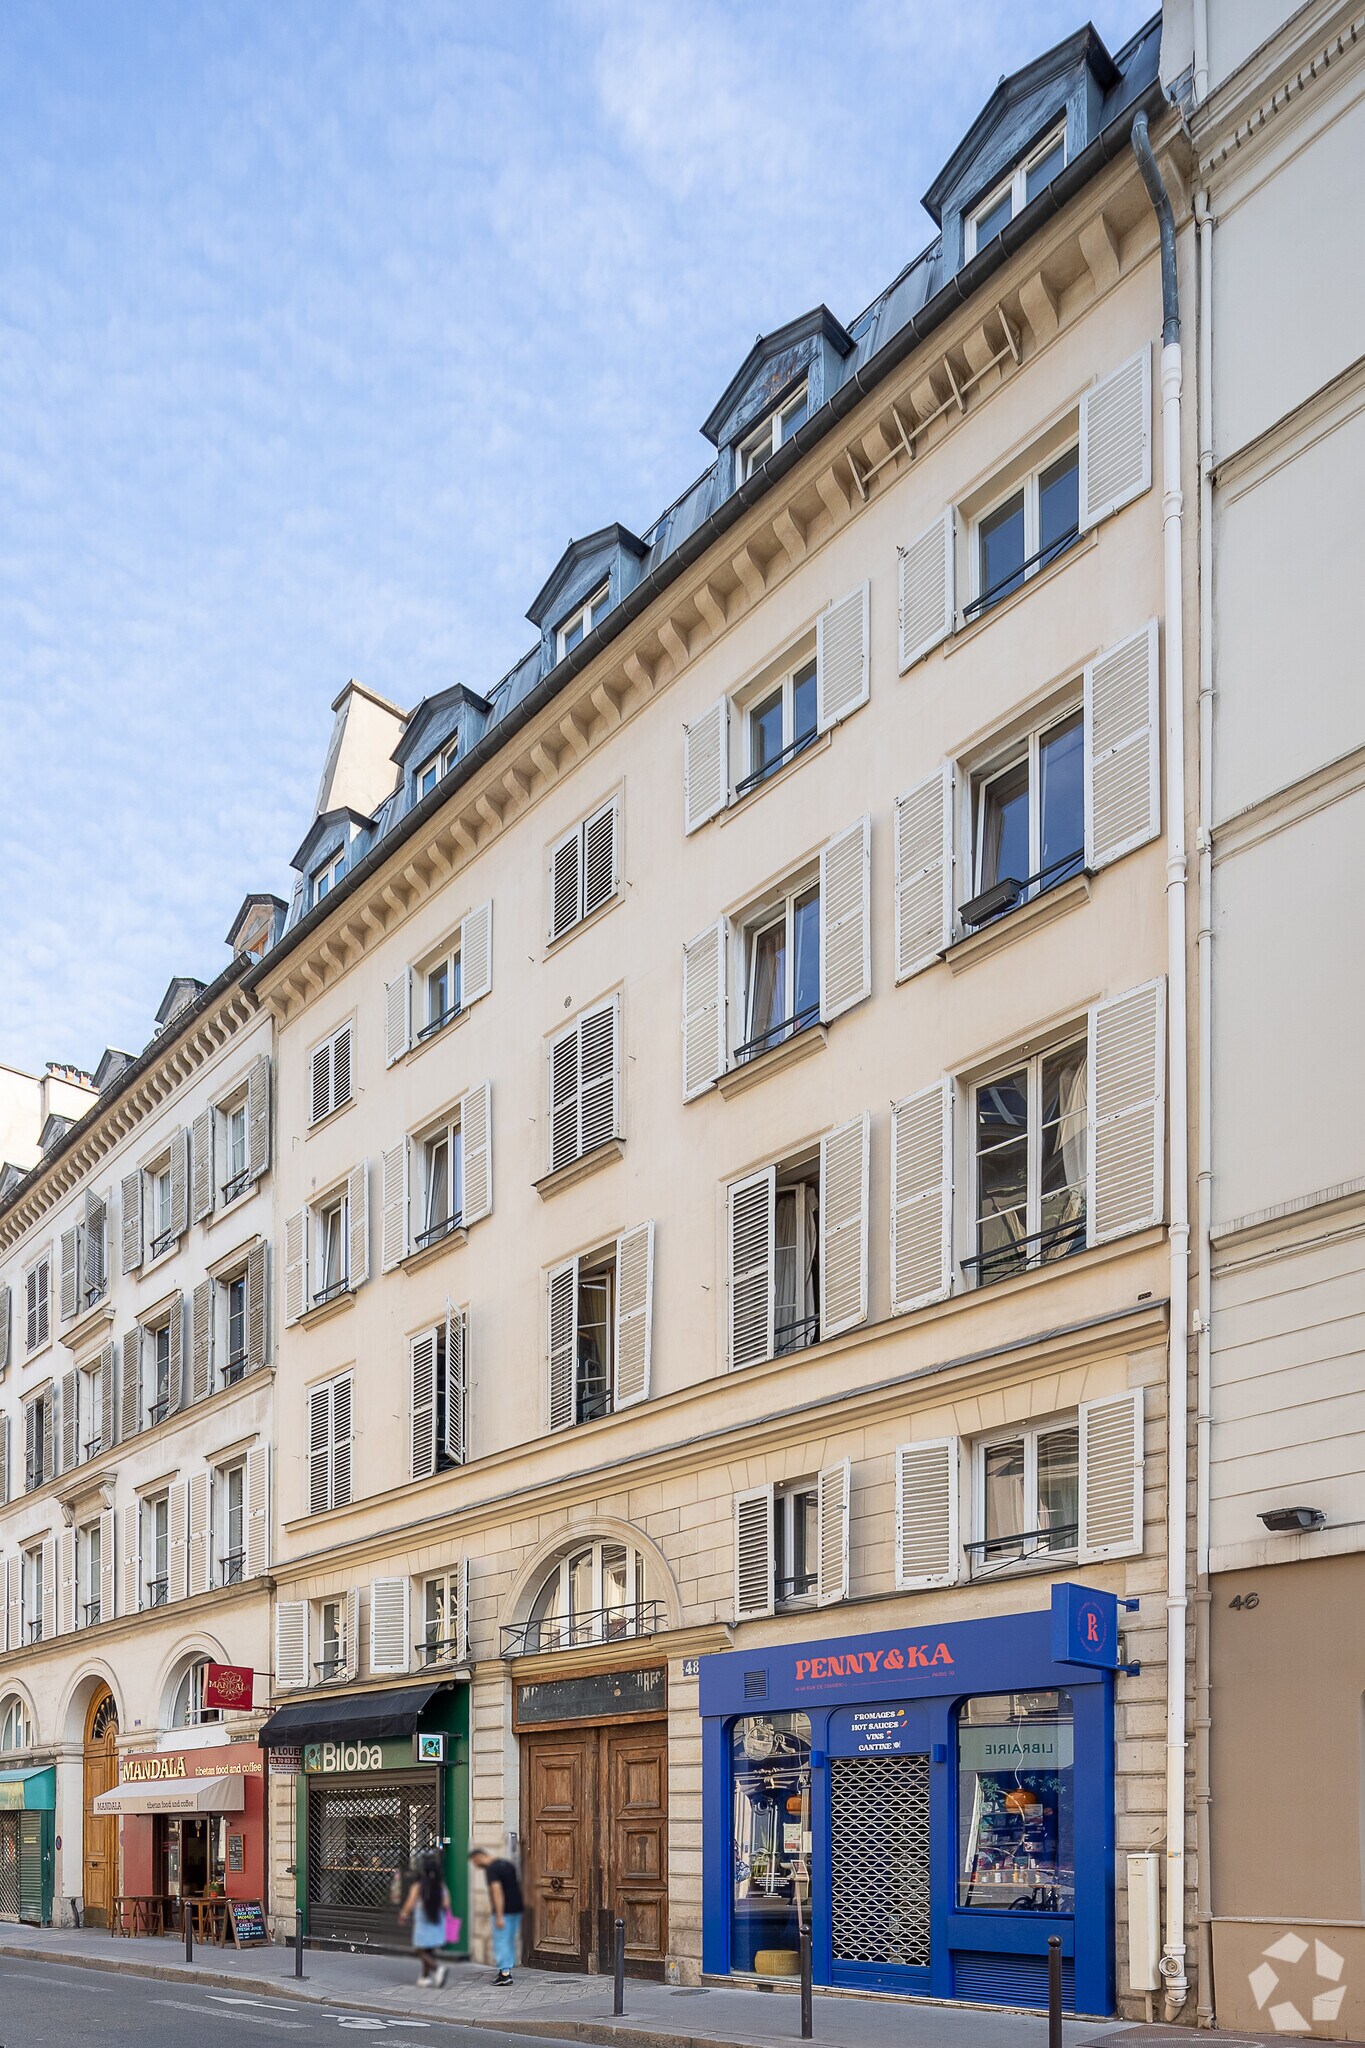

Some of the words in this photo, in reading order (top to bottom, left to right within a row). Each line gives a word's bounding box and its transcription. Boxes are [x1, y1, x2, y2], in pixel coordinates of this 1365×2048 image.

[1229, 1592, 1260, 1611] 46
[795, 1642, 955, 1681] PENNY&KA
[685, 1660, 699, 1675] 48
[854, 1711, 896, 1721] FROMAGES
[851, 1723, 868, 1731] HOT
[868, 1721, 899, 1730] SAUCES
[271, 1747, 276, 1755] A
[858, 1742, 892, 1751] CANTINE
[122, 1756, 187, 1781] MANDALA
[195, 1766, 215, 1776] tibetan
[215, 1764, 229, 1775] food
[229, 1763, 241, 1773] and
[242, 1761, 262, 1773] coffee
[97, 1802, 122, 1811] MANDALA
[161, 1800, 172, 1808] food
